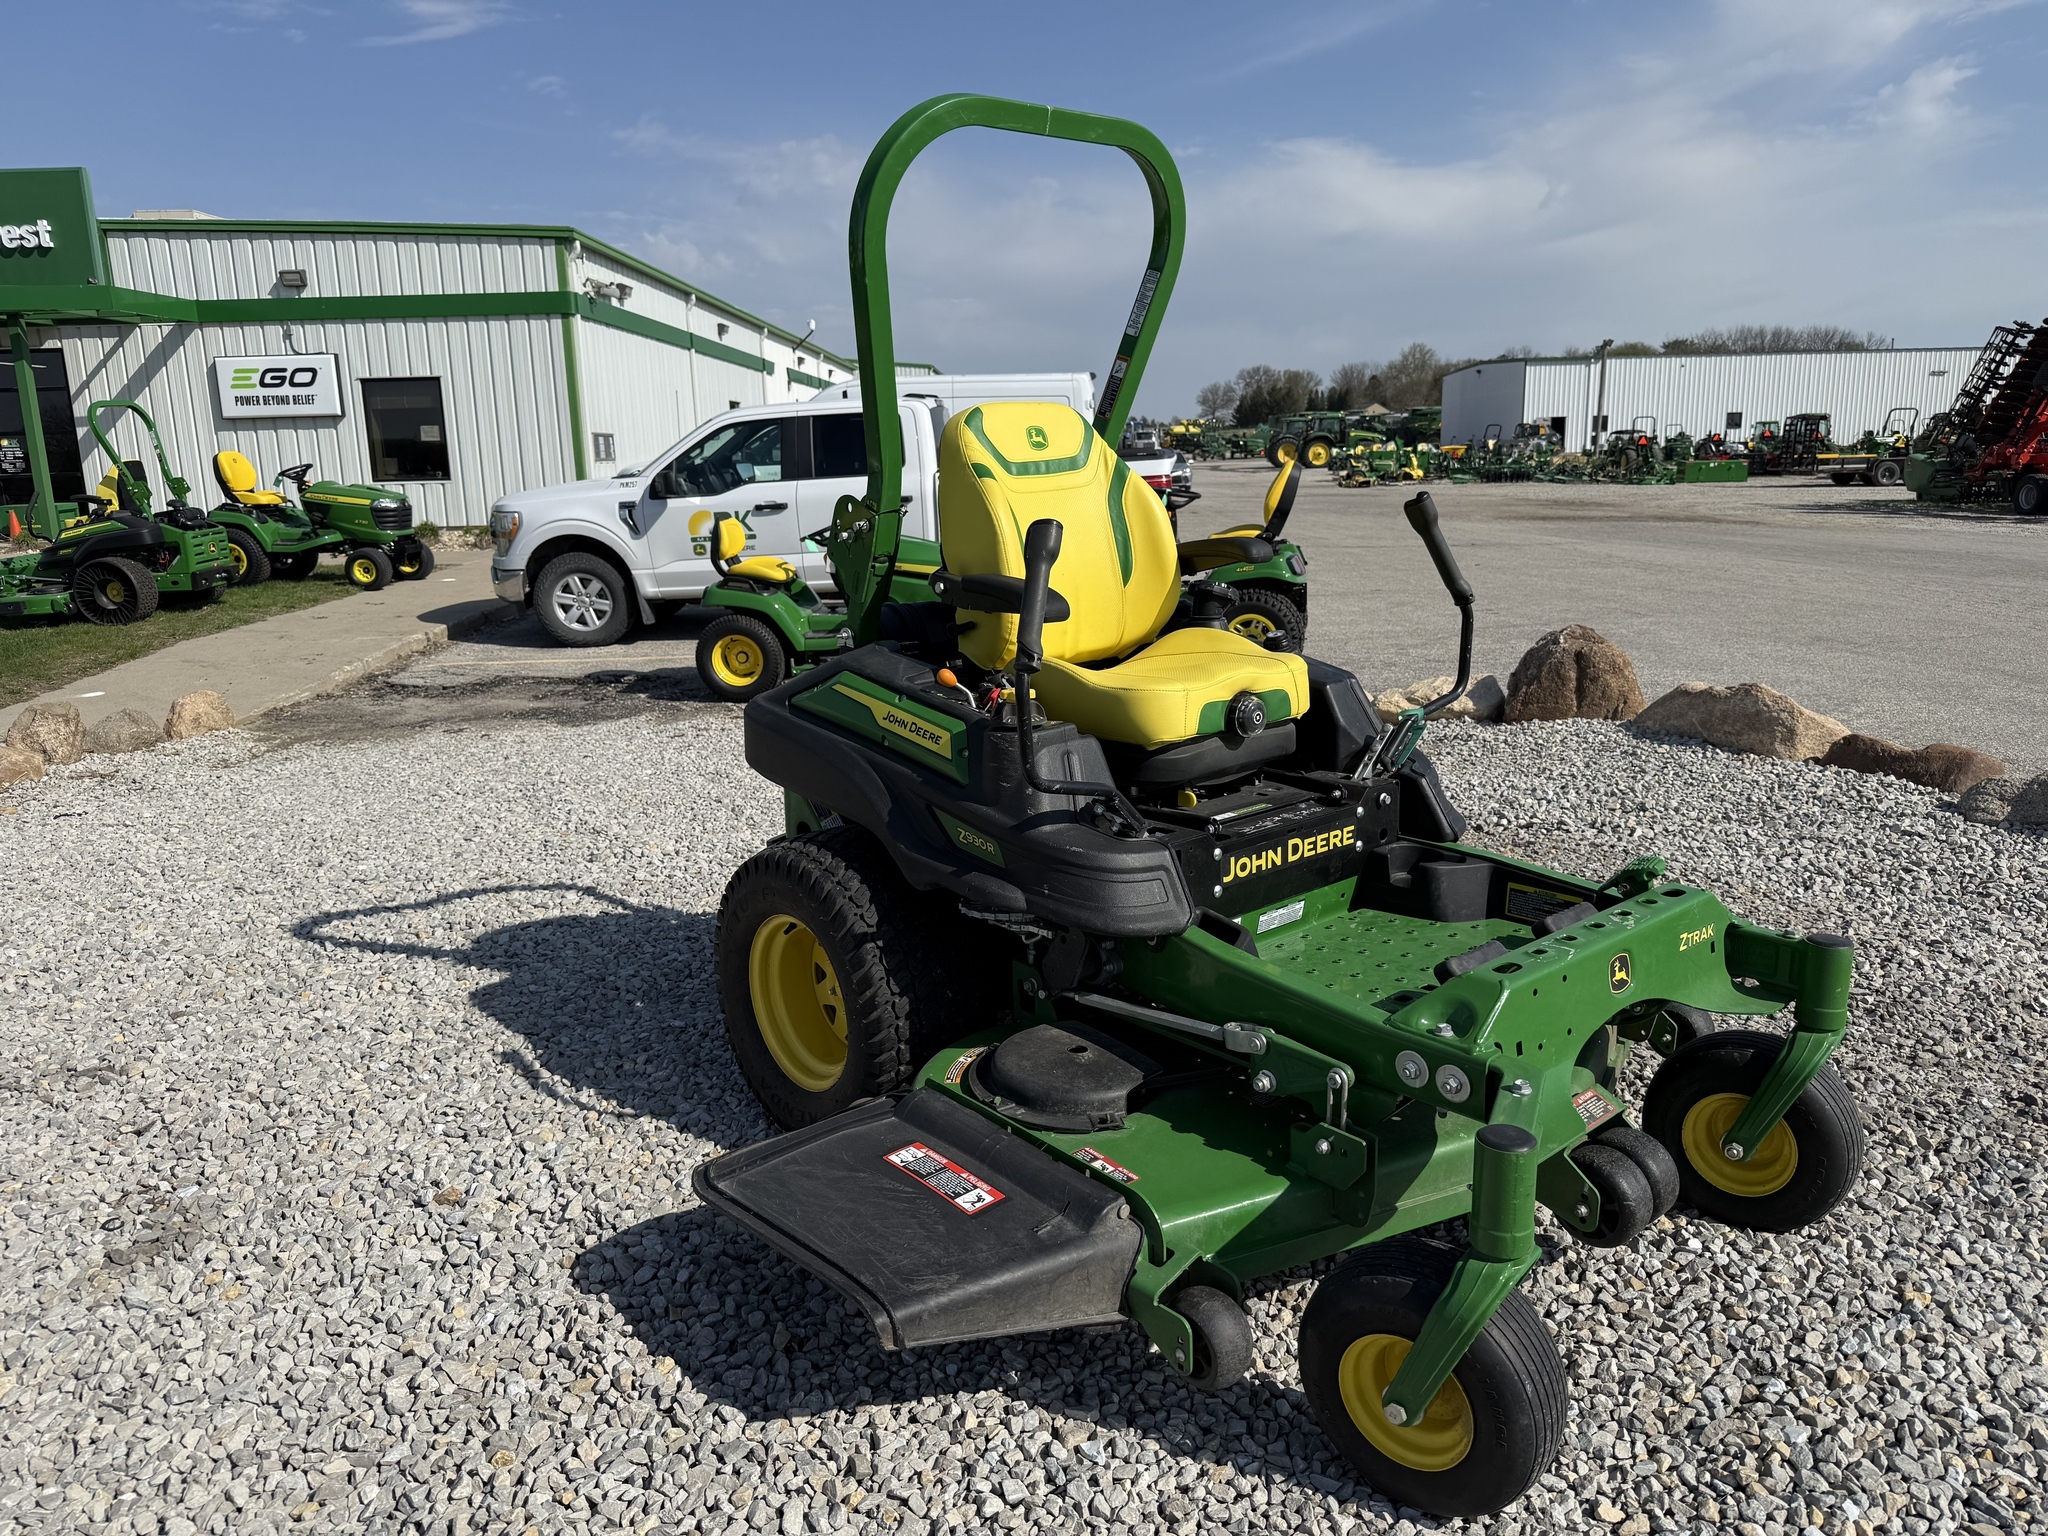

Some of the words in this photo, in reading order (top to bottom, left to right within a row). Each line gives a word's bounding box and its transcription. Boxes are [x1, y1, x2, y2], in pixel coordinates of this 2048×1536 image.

[0, 219, 54, 249] est
[234, 395, 261, 406] POWER
[263, 395, 291, 406] BEYOND
[292, 394, 316, 405] BELIEF
[882, 710, 909, 730] JOHN
[909, 721, 943, 746] DEERE
[956, 827, 995, 855] Z930R
[1222, 847, 1282, 883] JOHN
[1287, 825, 1355, 863] DEERE
[1679, 922, 1715, 952] ZTRAK
